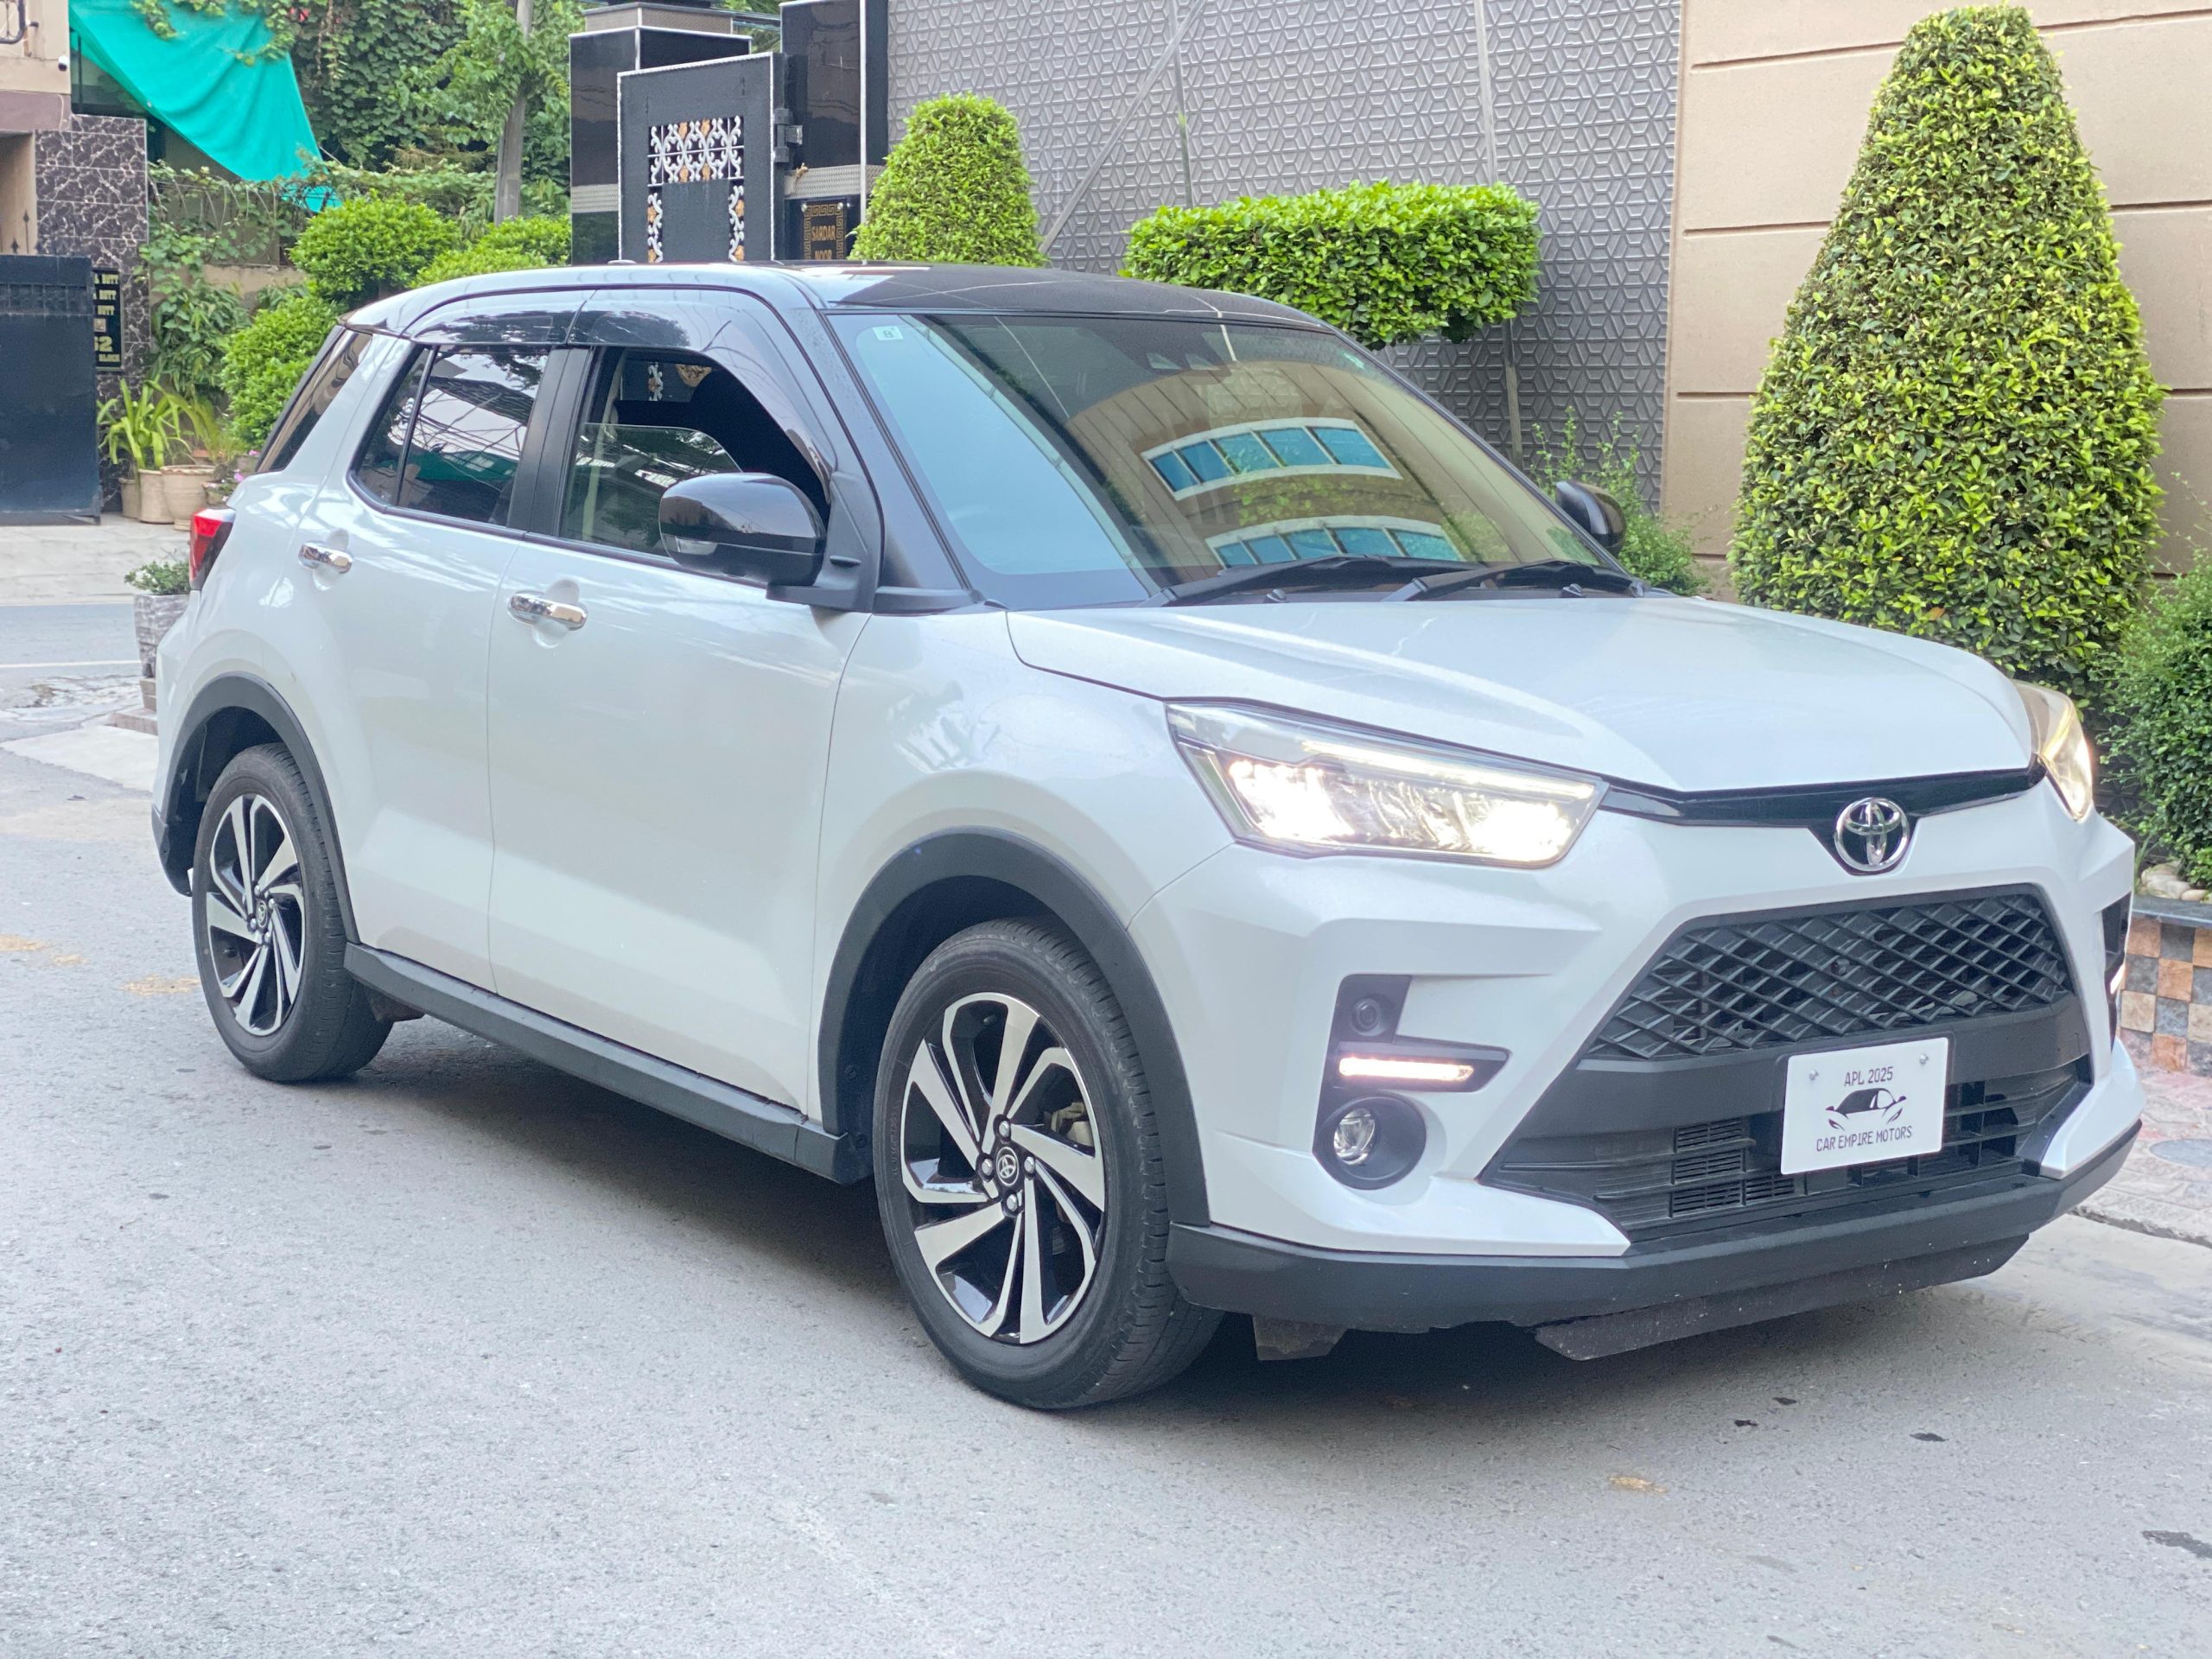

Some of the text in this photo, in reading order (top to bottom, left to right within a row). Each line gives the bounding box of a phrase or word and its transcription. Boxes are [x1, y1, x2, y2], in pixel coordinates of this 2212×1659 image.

[811, 225, 836, 241] SARDAR
[1844, 1065, 1893, 1087] APL 2025
[1816, 1125, 1912, 1152] CAR EMPIRE MOTORS
